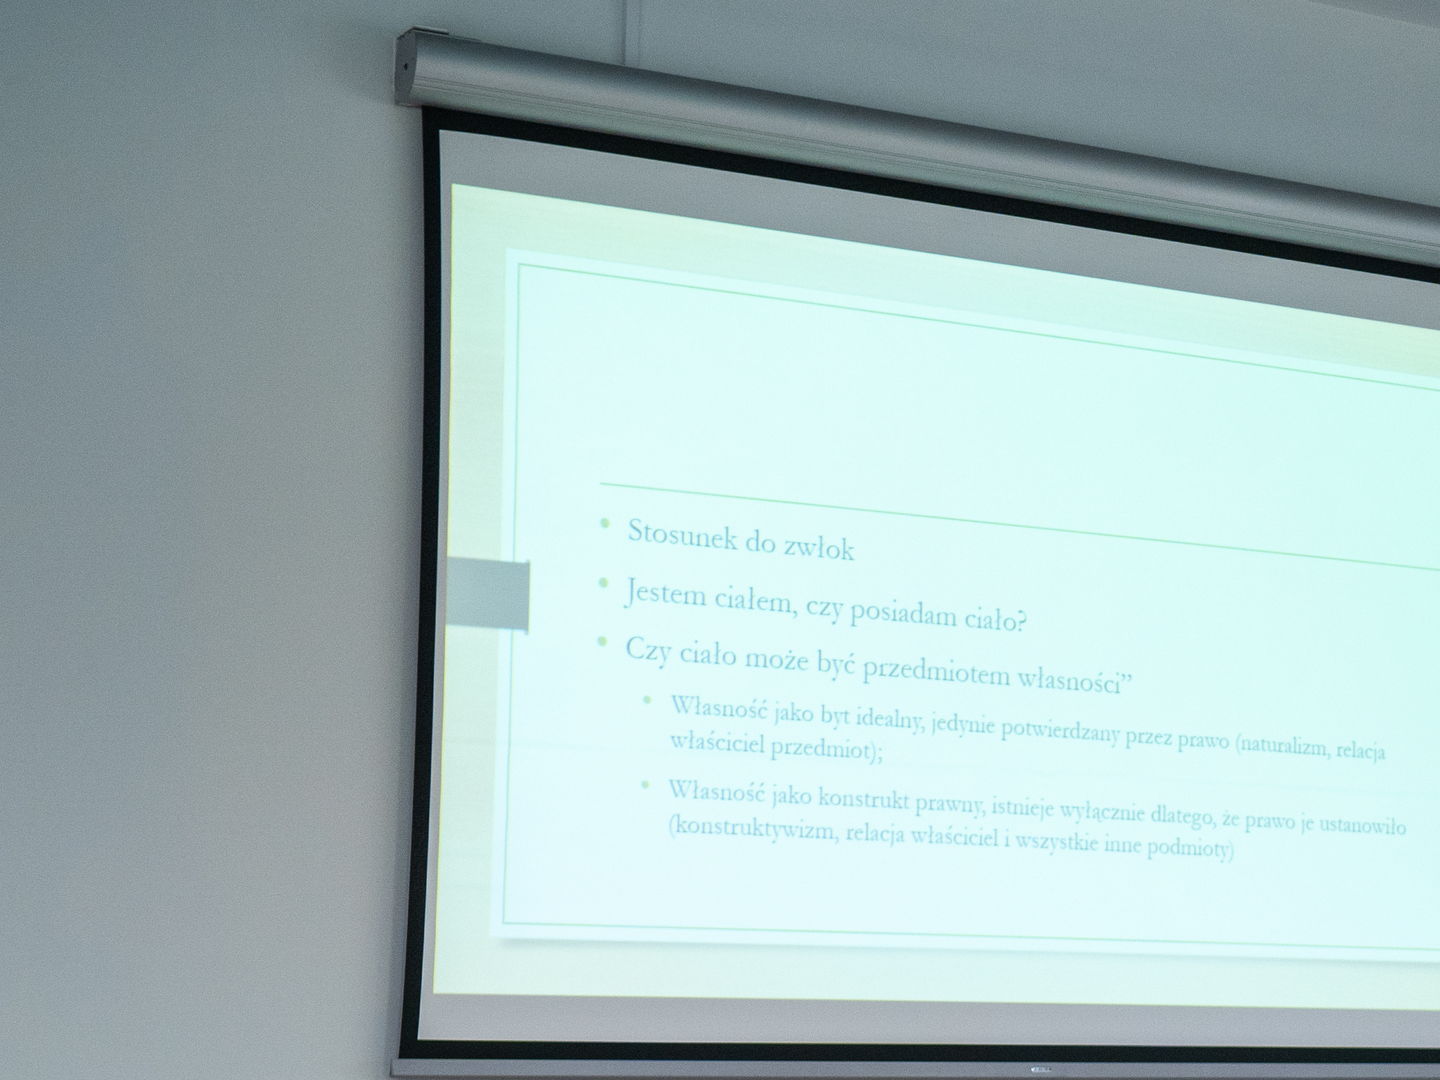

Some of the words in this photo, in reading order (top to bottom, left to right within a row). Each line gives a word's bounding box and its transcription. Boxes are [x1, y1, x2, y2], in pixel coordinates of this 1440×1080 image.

[628, 518, 738, 550] Stosunek
[745, 529, 776, 554] do
[784, 535, 855, 561] zwłok
[623, 577, 707, 609] Jestem
[715, 585, 798, 619] ciałem,
[806, 600, 844, 626] czy
[850, 599, 957, 628] posiadam
[964, 606, 1027, 632] ciało?
[625, 635, 672, 670] Czy
[679, 640, 737, 666] ciało
[745, 650, 809, 671] może
[816, 649, 855, 682] być
[863, 656, 1011, 686] przedmiotem
[669, 730, 765, 754] właściciel
[770, 738, 883, 765] przedmiot);
[671, 694, 768, 719] Własność
[774, 701, 814, 725] jako
[820, 704, 850, 730] byt
[856, 706, 926, 736] idealny,
[931, 711, 995, 739] jedynie
[1001, 719, 1121, 748] potwierdzany
[1125, 731, 1173, 750] przez
[1177, 734, 1231, 753] prawo
[1235, 733, 1332, 760] (naturalizm,
[1336, 740, 1386, 764] relacja
[668, 778, 766, 802] Własność
[772, 784, 813, 808] jako
[817, 786, 910, 810] konstrukt
[915, 797, 986, 819] prawny,
[991, 795, 1055, 822] istnieje
[1059, 800, 1145, 824] wyłącznie
[1150, 804, 1218, 831] dlatego,
[1222, 810, 1240, 827] że
[1244, 815, 1296, 834] prawo
[1301, 812, 1315, 835] je
[1319, 817, 1407, 836] ustanowiło
[668, 813, 840, 845] (konstruktywizm,
[845, 822, 905, 847] relacja
[910, 825, 1000, 847] właściciel
[1003, 829, 1011, 848] i
[1015, 832, 1099, 856] wszystkie
[1104, 833, 1142, 854] inne
[1147, 837, 1235, 864] podmioty)
